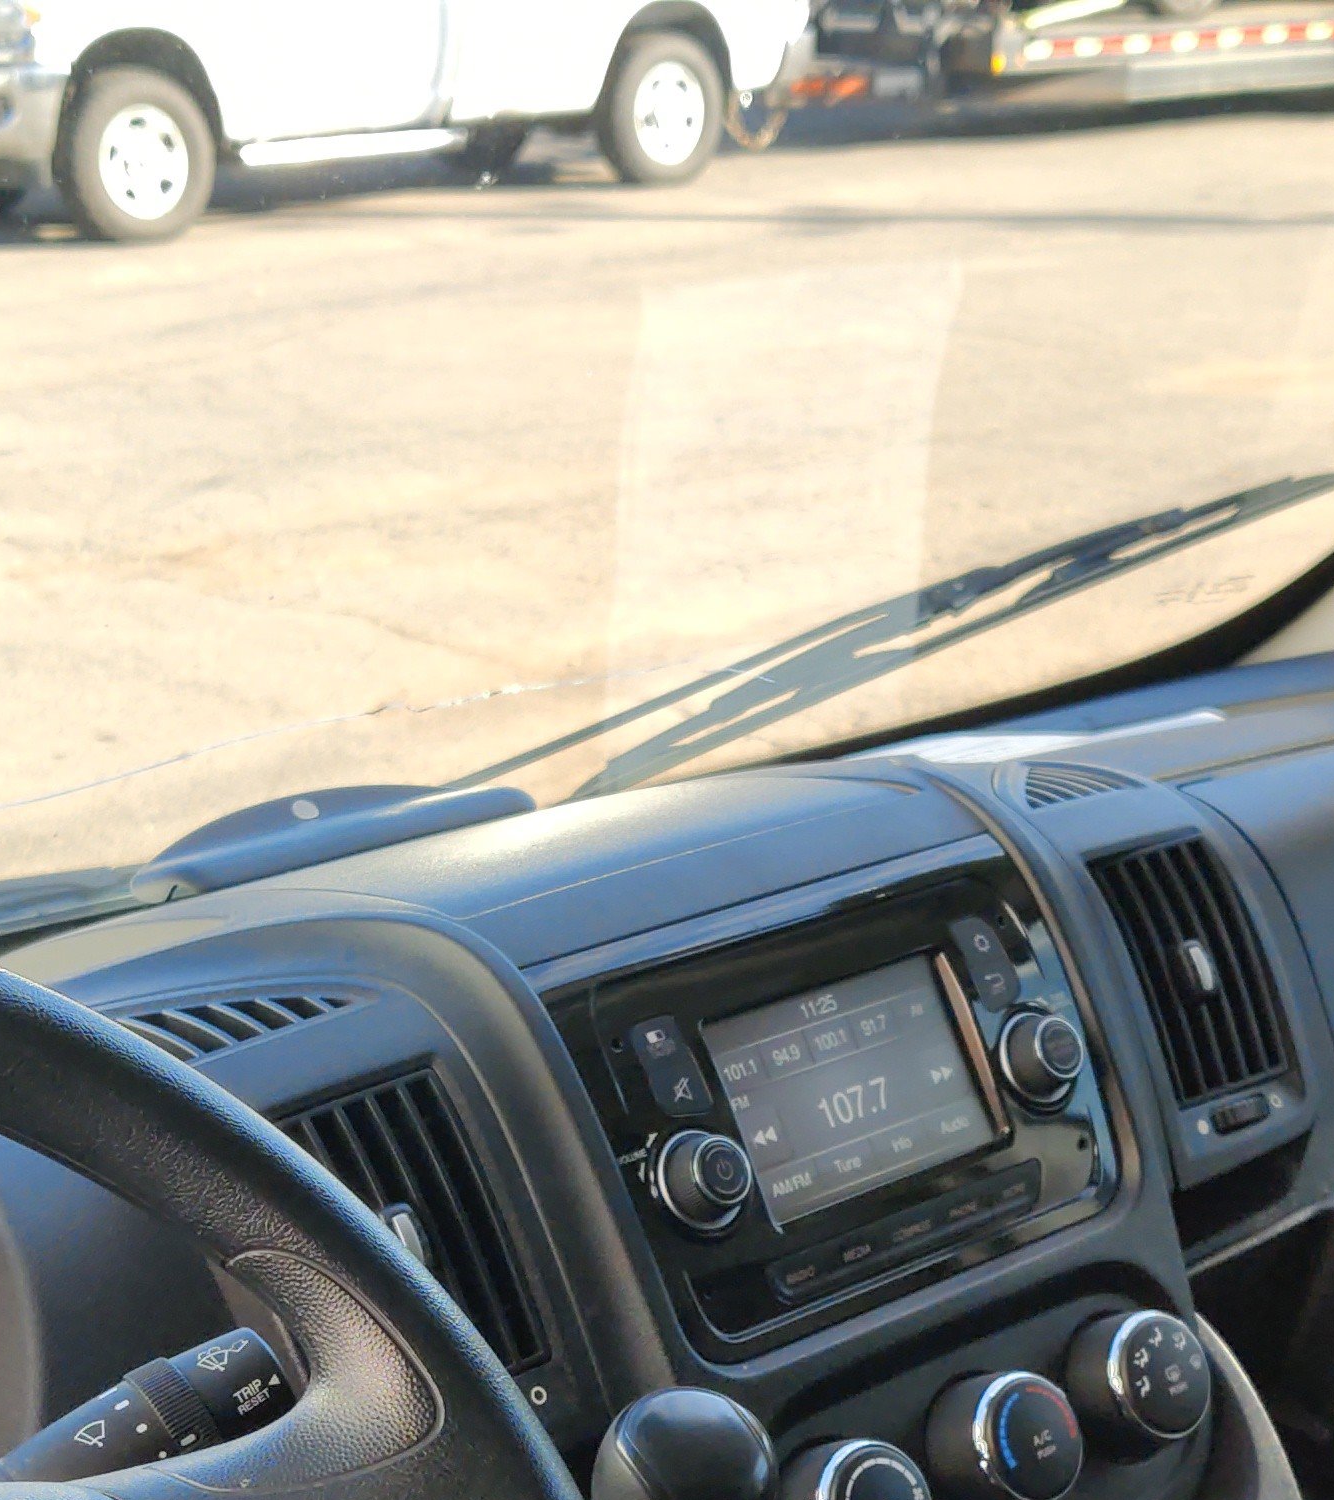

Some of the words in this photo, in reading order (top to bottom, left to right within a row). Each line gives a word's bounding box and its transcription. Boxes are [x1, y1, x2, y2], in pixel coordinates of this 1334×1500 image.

[723, 1059, 758, 1083] 101.1
[730, 1094, 750, 1112] FM
[818, 1076, 888, 1129] 107.7
[833, 1155, 863, 1174] Tune
[232, 1378, 262, 1404] TRIP
[237, 1387, 270, 1416] RESET
